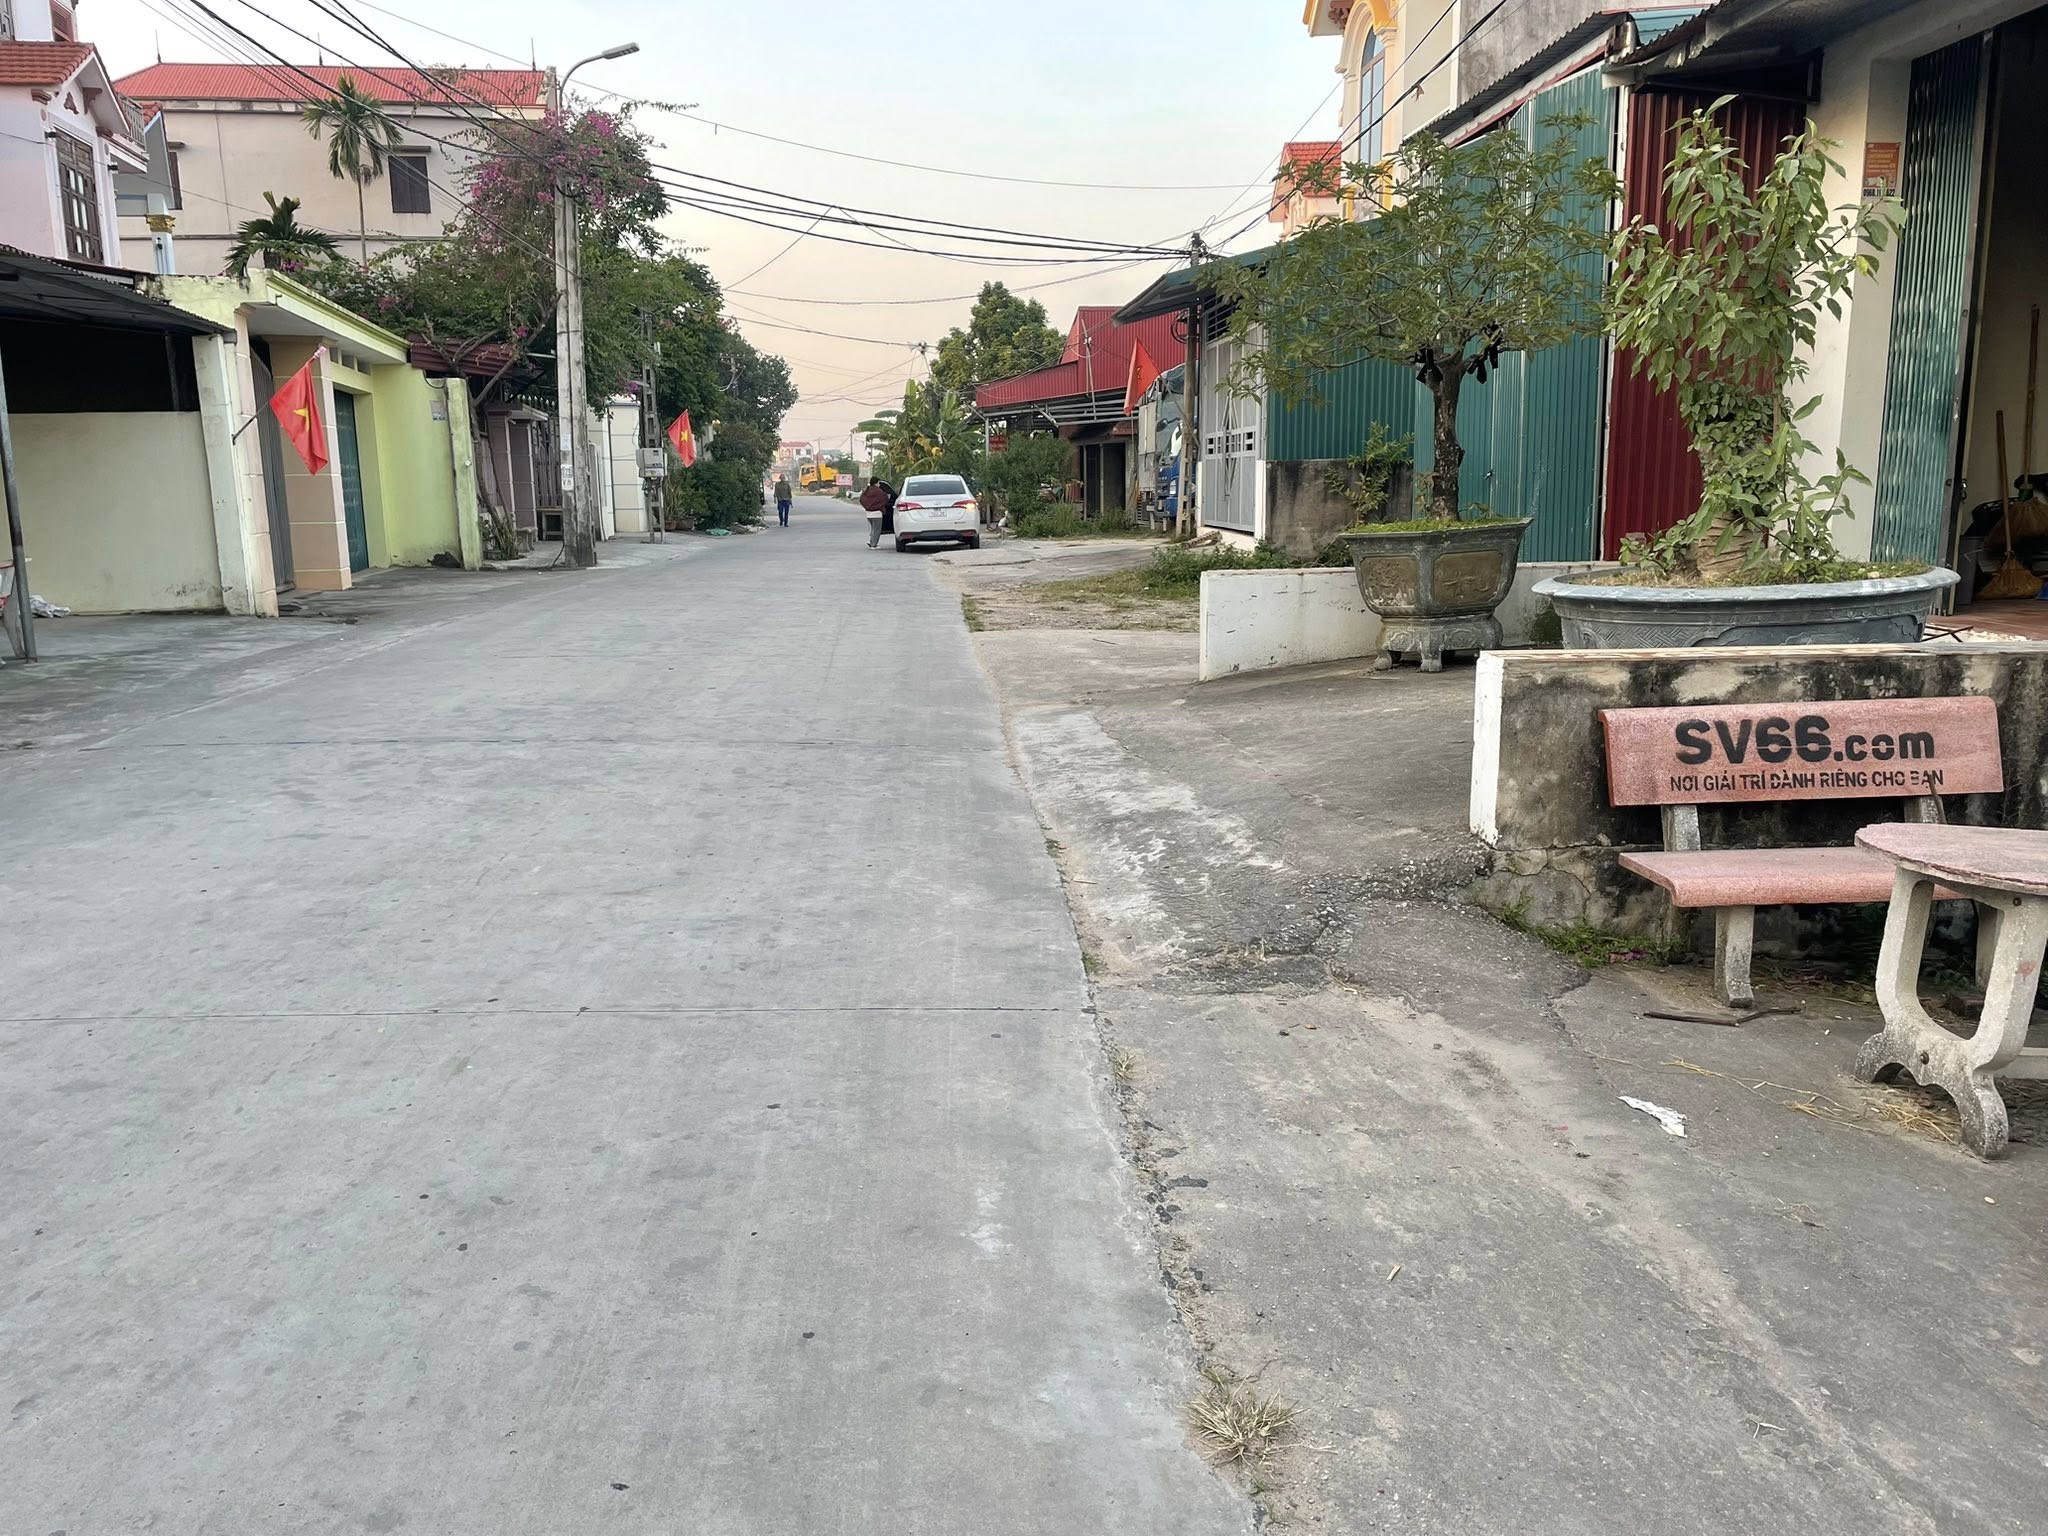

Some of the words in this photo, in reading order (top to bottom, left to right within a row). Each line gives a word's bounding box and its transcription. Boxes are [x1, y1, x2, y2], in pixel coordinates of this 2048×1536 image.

[1675, 715, 1935, 765] SV66.com
[1670, 774, 1698, 792] NƠI
[1703, 769, 1736, 791] GIẢI
[1740, 770, 1766, 790] TRÍ
[1770, 769, 1815, 789] DÀNH
[1819, 768, 1868, 788] RIÊNG
[1871, 771, 1906, 787] CHO
